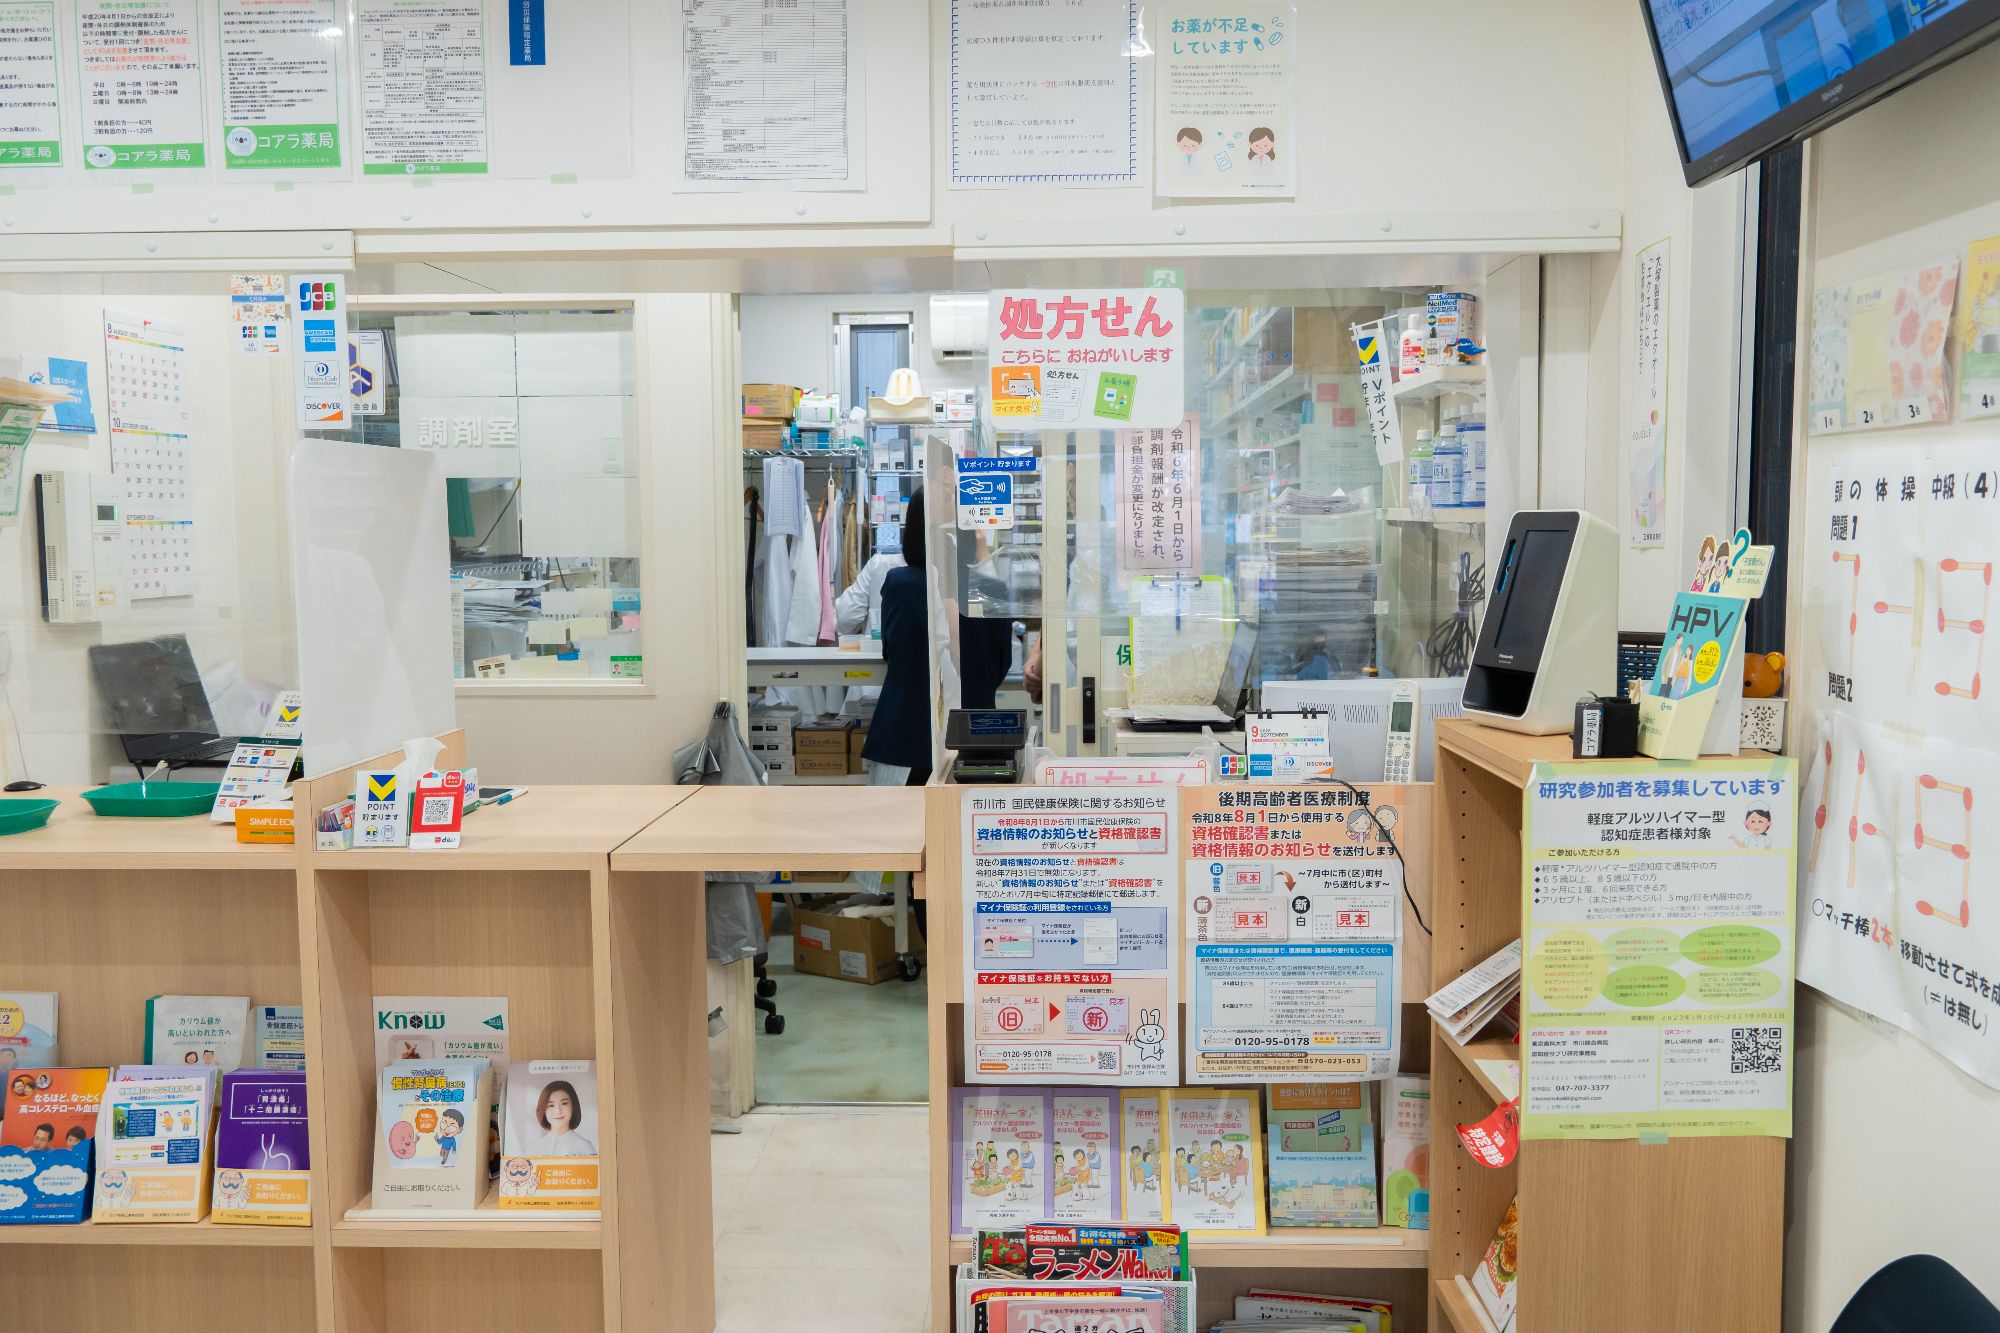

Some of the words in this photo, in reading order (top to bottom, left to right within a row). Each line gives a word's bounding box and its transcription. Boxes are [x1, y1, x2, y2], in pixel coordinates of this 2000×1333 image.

[1171, 17, 1249, 34] お薬が不足
[1172, 38, 1248, 55] しています
[1821, 84, 1843, 101] SHARP
[257, 132, 334, 149] コアラ薬局
[117, 149, 191, 162] コアラ薬局
[1000, 296, 1174, 341] 処方せん
[1001, 350, 1061, 364] こちらに
[1068, 348, 1173, 364] おねがいします
[1047, 370, 1080, 380] 処方せん
[1371, 379, 1391, 444] Vポイント
[418, 416, 518, 447] 調剤室
[963, 461, 996, 469] Vポイント
[997, 460, 1031, 468] 貯まります
[1150, 428, 1165, 560] 調剤報酬が改定され、
[1171, 429, 1184, 561] 令和6年6月1日から
[1830, 515, 1858, 541] 問題1
[1671, 604, 1734, 638] HPV
[1828, 671, 1853, 702] 問題2
[1251, 725, 1259, 737] 9
[1586, 711, 1598, 752] コアラ薬局
[1539, 778, 1785, 799] 研究参加者を募集しています
[972, 799, 1006, 809] 市川市
[1012, 797, 1166, 809] 国民健康保険に関するお知らせ
[1218, 791, 1371, 807] 後期高齢者医療制度
[250, 817, 276, 826] SIMPLE
[362, 813, 399, 821] 貯まります
[1191, 809, 1345, 824] 令和8年8月1日から使用する
[1587, 810, 1726, 826] 軽度アルツハイマー型
[977, 828, 1162, 841] 資格情報のお知らせと資格確認書
[1191, 826, 1302, 841] 資格確認書または
[1601, 826, 1711, 841] 認知症患者様対象
[1041, 841, 1098, 849] が新しくなります
[1191, 842, 1397, 858] 資格情報のお知らせを送付します
[1548, 848, 1620, 857] ご参加いただける方
[976, 858, 1125, 867] 現在の資格情報のお知らせと資格確認書は
[1239, 873, 1260, 883] 見本
[979, 903, 1109, 912] マイナ保険証の利用登録をされている方
[1237, 914, 1265, 926] 見本
[1297, 916, 1306, 926] 白
[1338, 913, 1368, 926] 見本
[979, 974, 1109, 983] マイナ保険証をお持ちでない方
[1024, 997, 1040, 1005] 見本
[1109, 997, 1125, 1005] 見本
[180, 1017, 222, 1025] カリウム値が
[1003, 1011, 1018, 1028] 旧
[1086, 1011, 1103, 1028] 新
[168, 1028, 232, 1037] 高いといわれた方へ
[444, 1042, 504, 1050] 「カリウム値が高い」
[1234, 1037, 1310, 1046] 0120-95-0178
[1556, 1084, 1610, 1092] 047-707-3377
[33, 1093, 100, 1103] なるほど、なっとく
[415, 1089, 464, 1102] とその治療
[545, 1169, 572, 1177] ご自由に
[256, 1183, 282, 1191] ご自由に
[544, 1177, 593, 1185] お取りください。
[384, 1184, 462, 1192] ご自由にお取りください。
[255, 1192, 302, 1200] お取りください。
[1079, 1229, 1127, 1238] お得な特典
